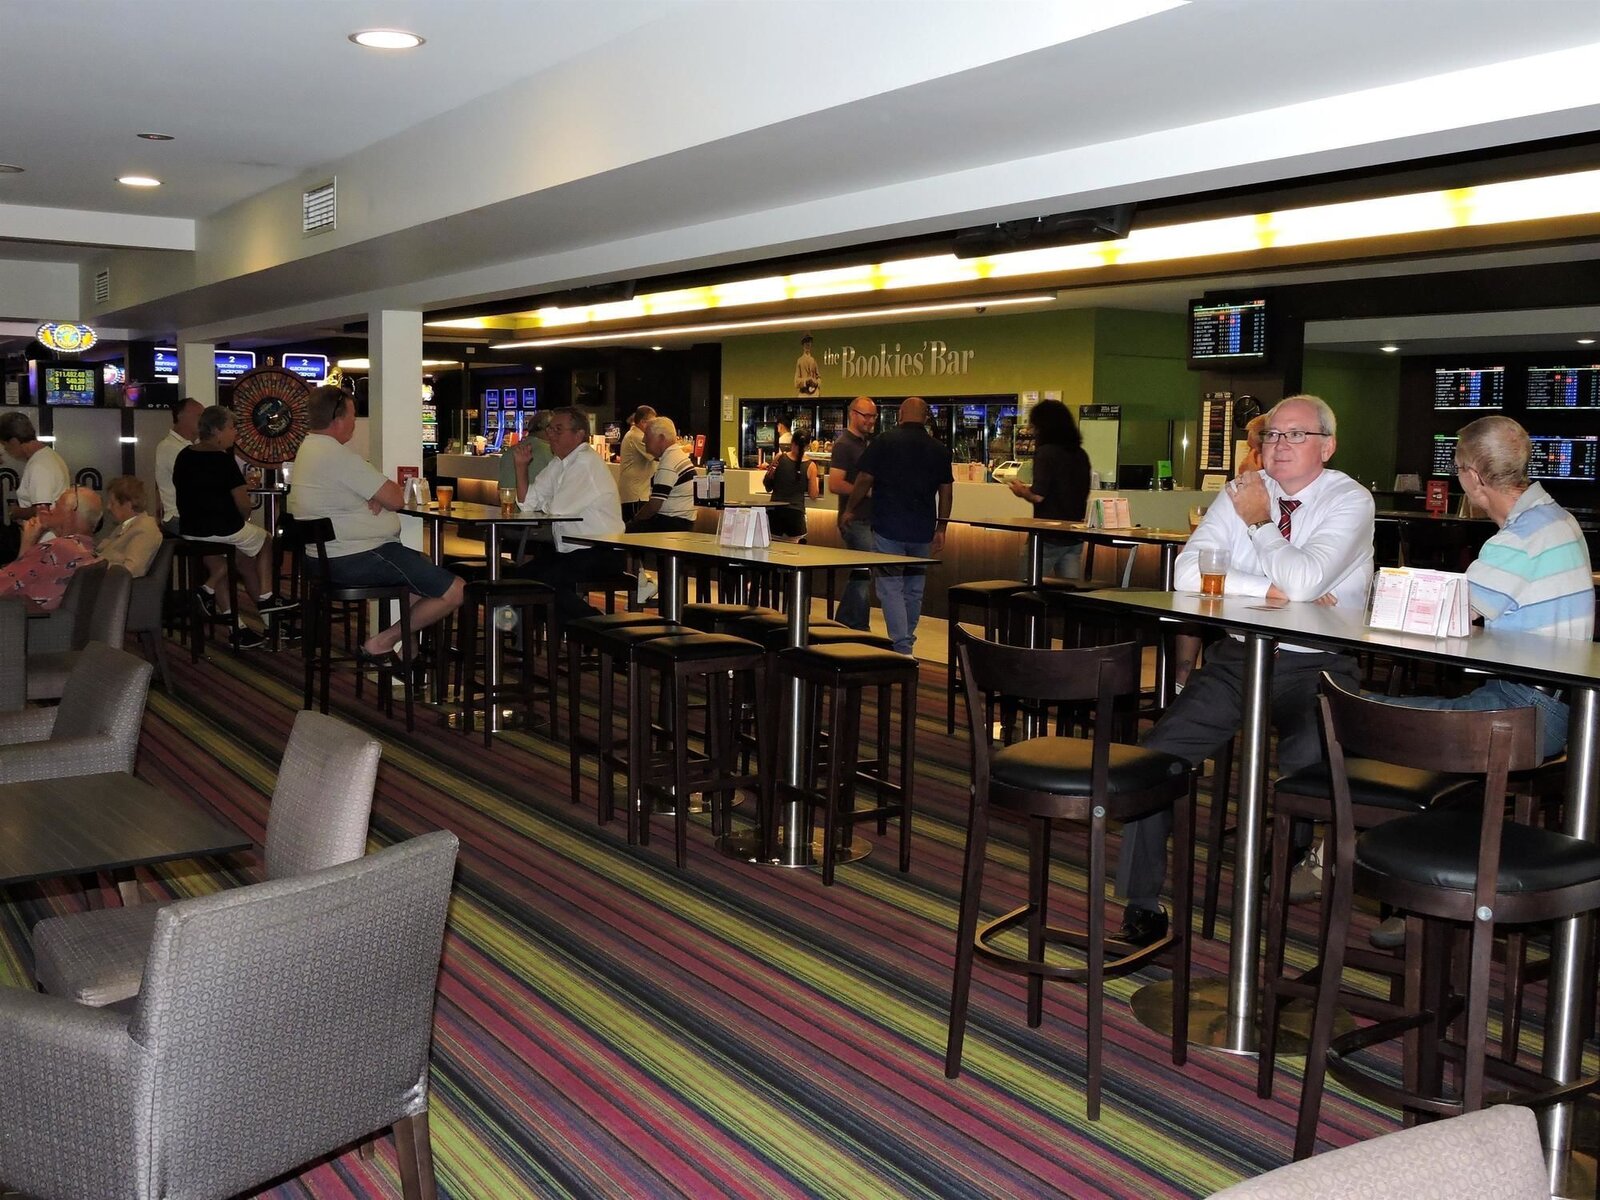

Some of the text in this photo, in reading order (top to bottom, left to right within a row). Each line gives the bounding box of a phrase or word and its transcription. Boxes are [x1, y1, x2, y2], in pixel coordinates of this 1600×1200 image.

[824, 340, 975, 379] the Bookies' Bar
